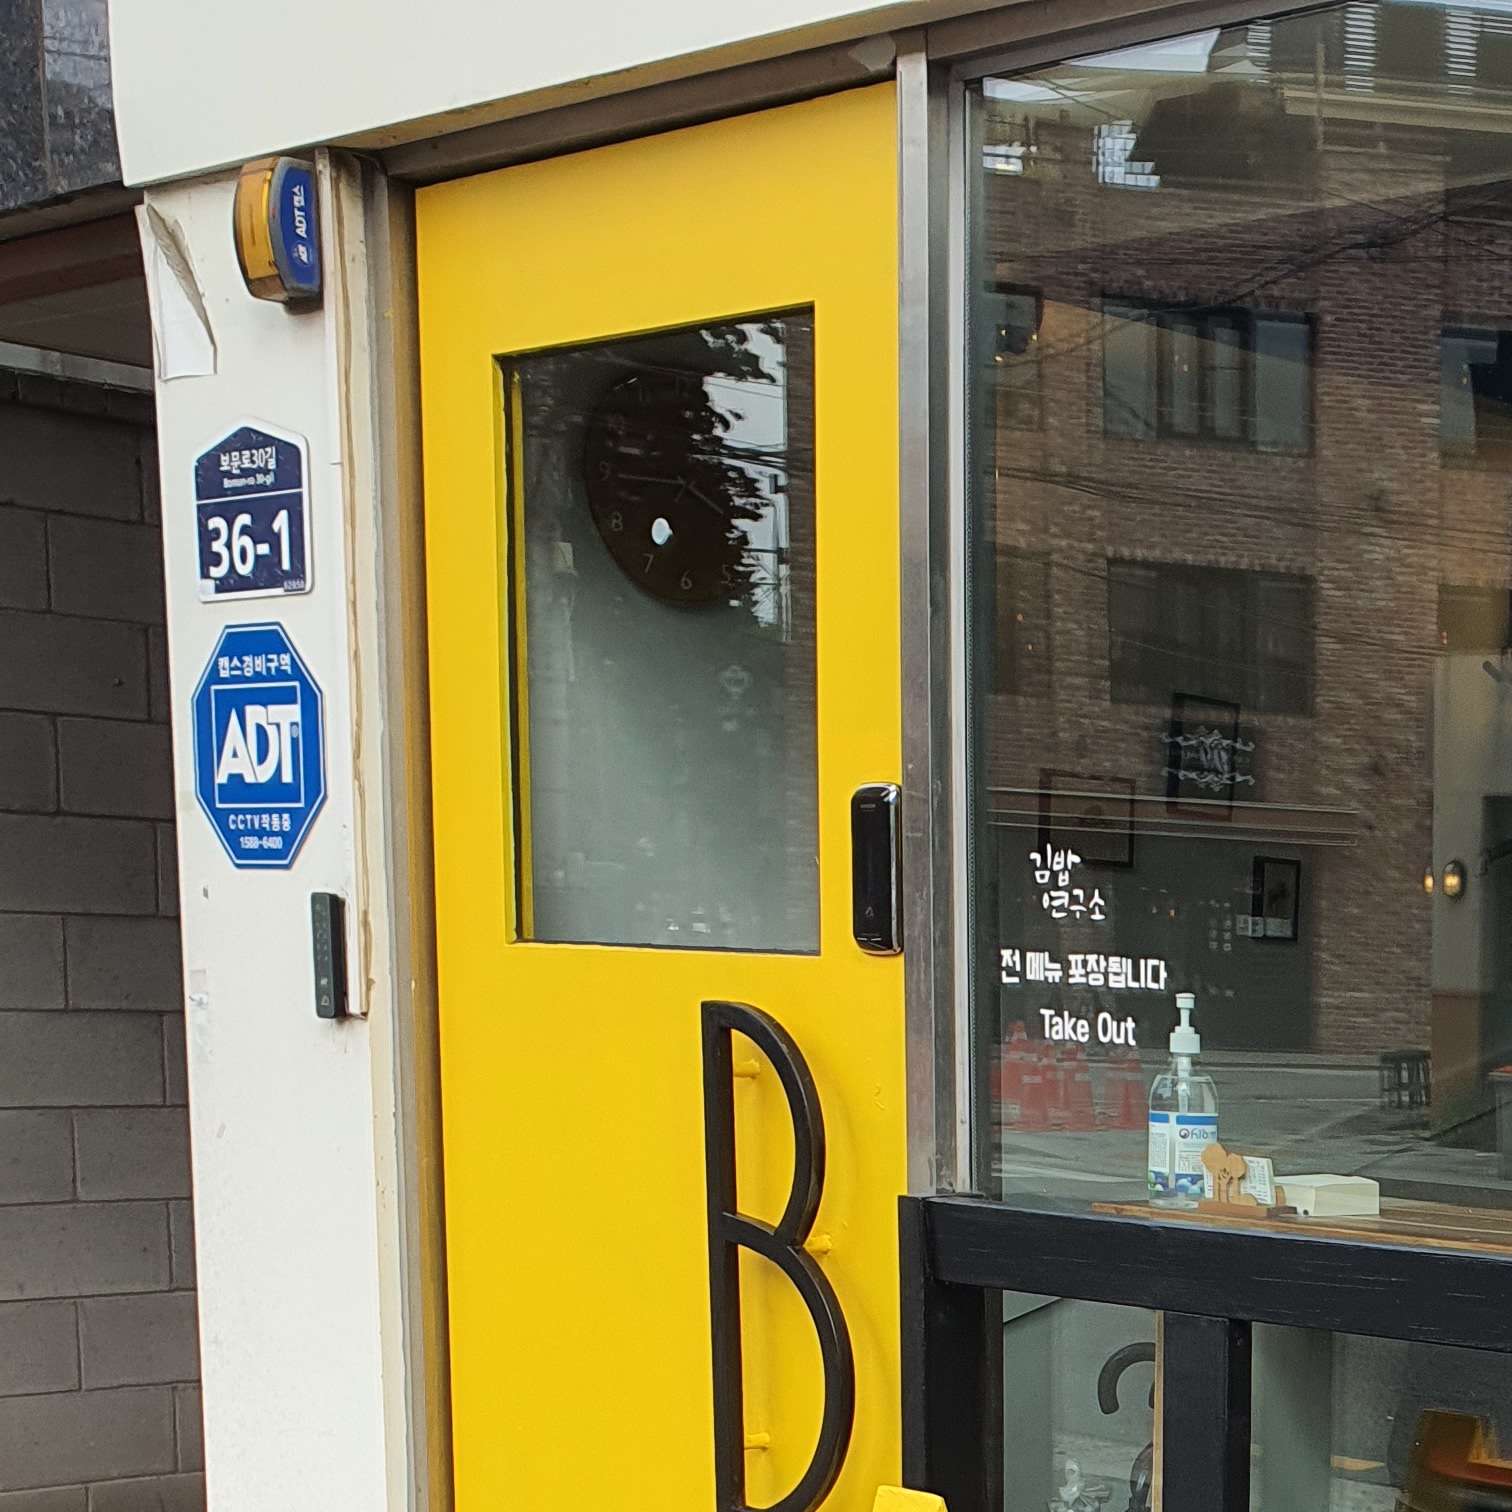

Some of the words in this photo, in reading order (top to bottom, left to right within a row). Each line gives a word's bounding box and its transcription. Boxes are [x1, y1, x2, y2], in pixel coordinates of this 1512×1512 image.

[294, 209, 307, 239] ADT
[219, 445, 276, 474] 보문로30길
[207, 509, 290, 578] 36-1
[217, 704, 300, 783] ADT
[1029, 843, 1081, 887] 김밥
[1042, 888, 1106, 921] 연구소
[1000, 948, 1021, 984] 전
[1026, 951, 1063, 983] 메뉴
[1068, 953, 1168, 990] 포장됩니다
[1039, 1008, 1090, 1043] Take
[1097, 1011, 1137, 1047] Out
